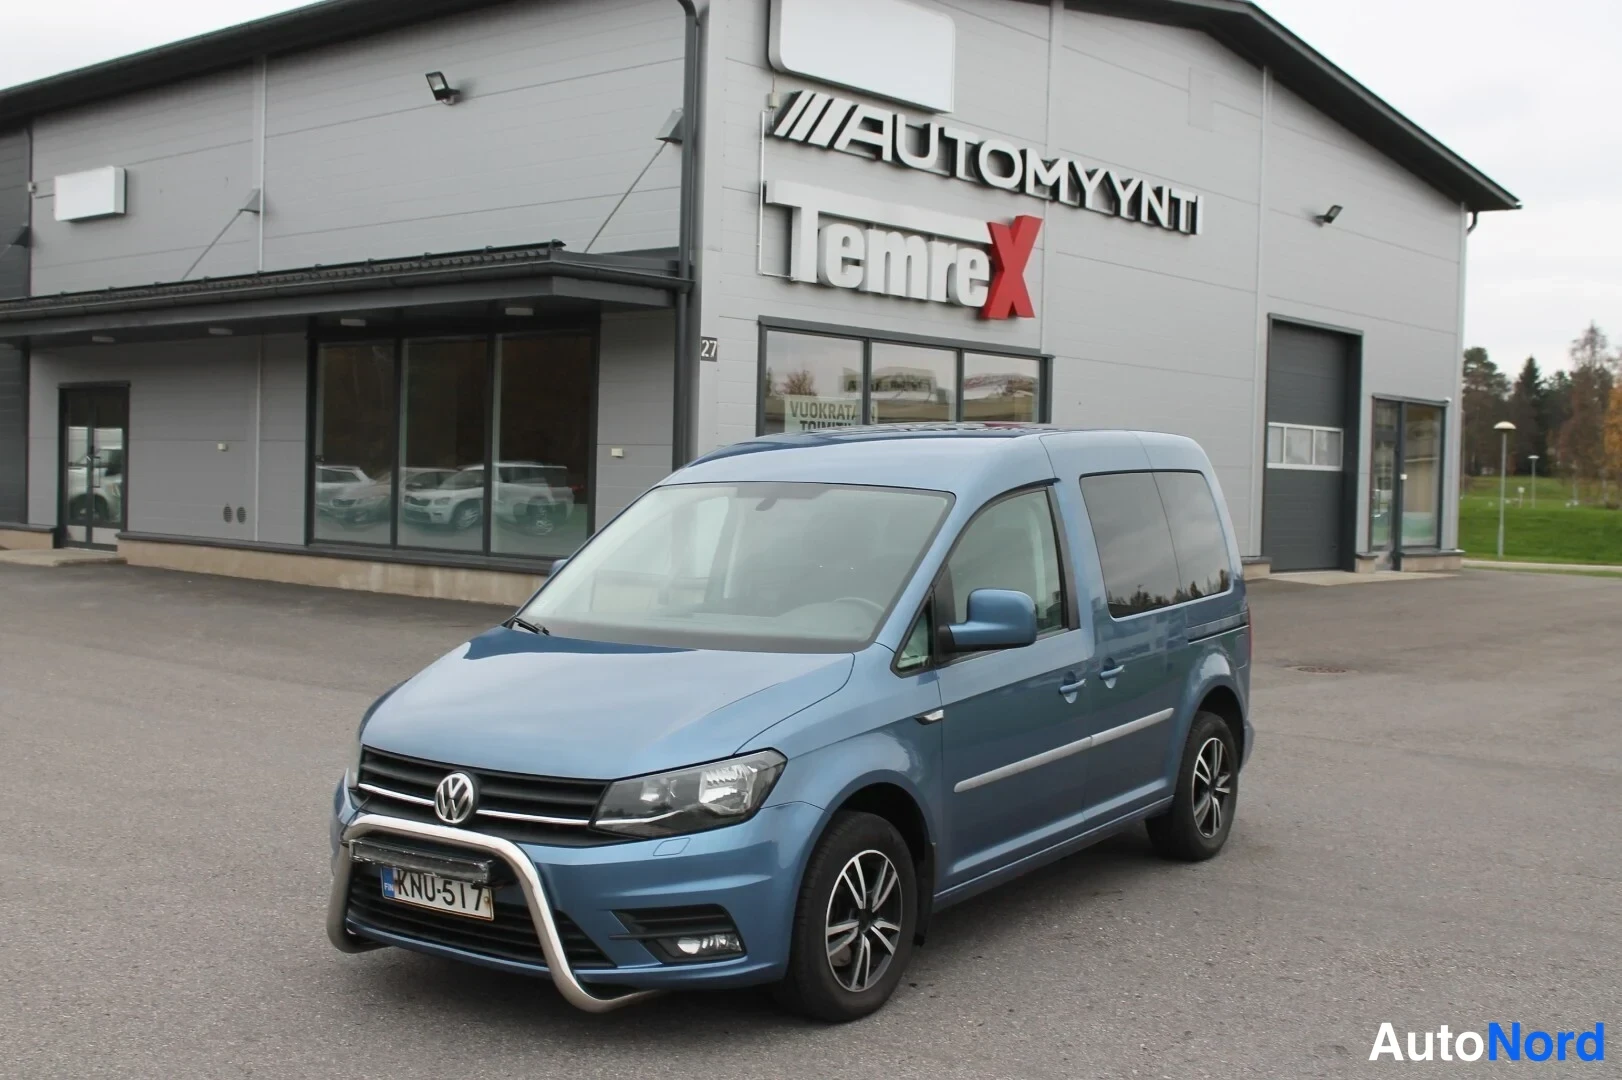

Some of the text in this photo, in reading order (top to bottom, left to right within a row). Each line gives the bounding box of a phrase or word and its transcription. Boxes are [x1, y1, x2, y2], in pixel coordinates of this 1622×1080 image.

[766, 180, 1043, 320] TemreX
[702, 340, 717, 357] 27
[397, 869, 484, 911] KNU-517
